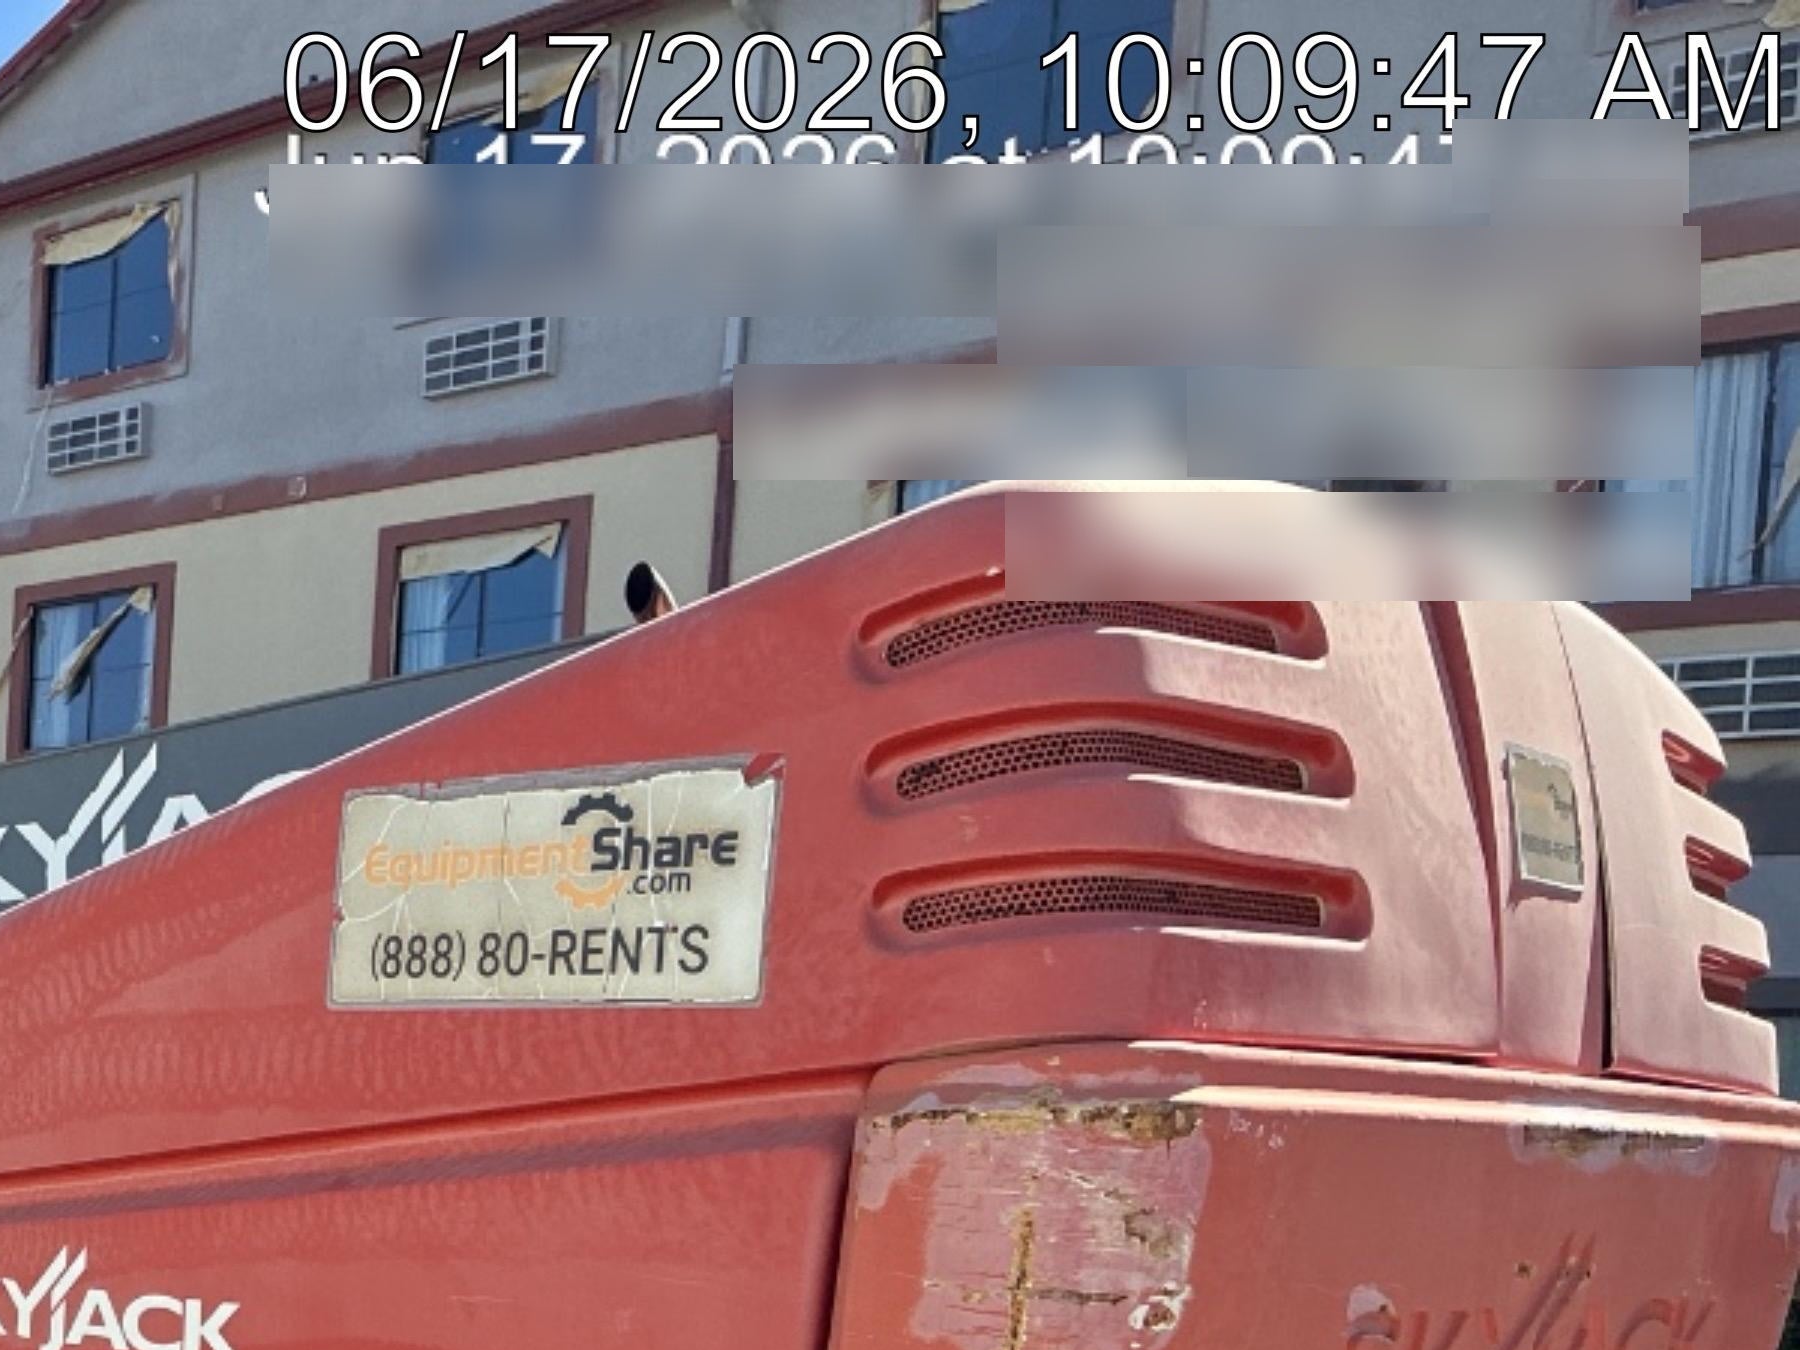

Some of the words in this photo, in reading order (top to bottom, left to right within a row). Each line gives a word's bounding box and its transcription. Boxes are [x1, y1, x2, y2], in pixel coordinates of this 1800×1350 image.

[364, 828, 740, 889] EquipmentShare
[627, 871, 692, 895] .com
[371, 930, 466, 981] (888)
[477, 923, 711, 977] 80-RENTS
